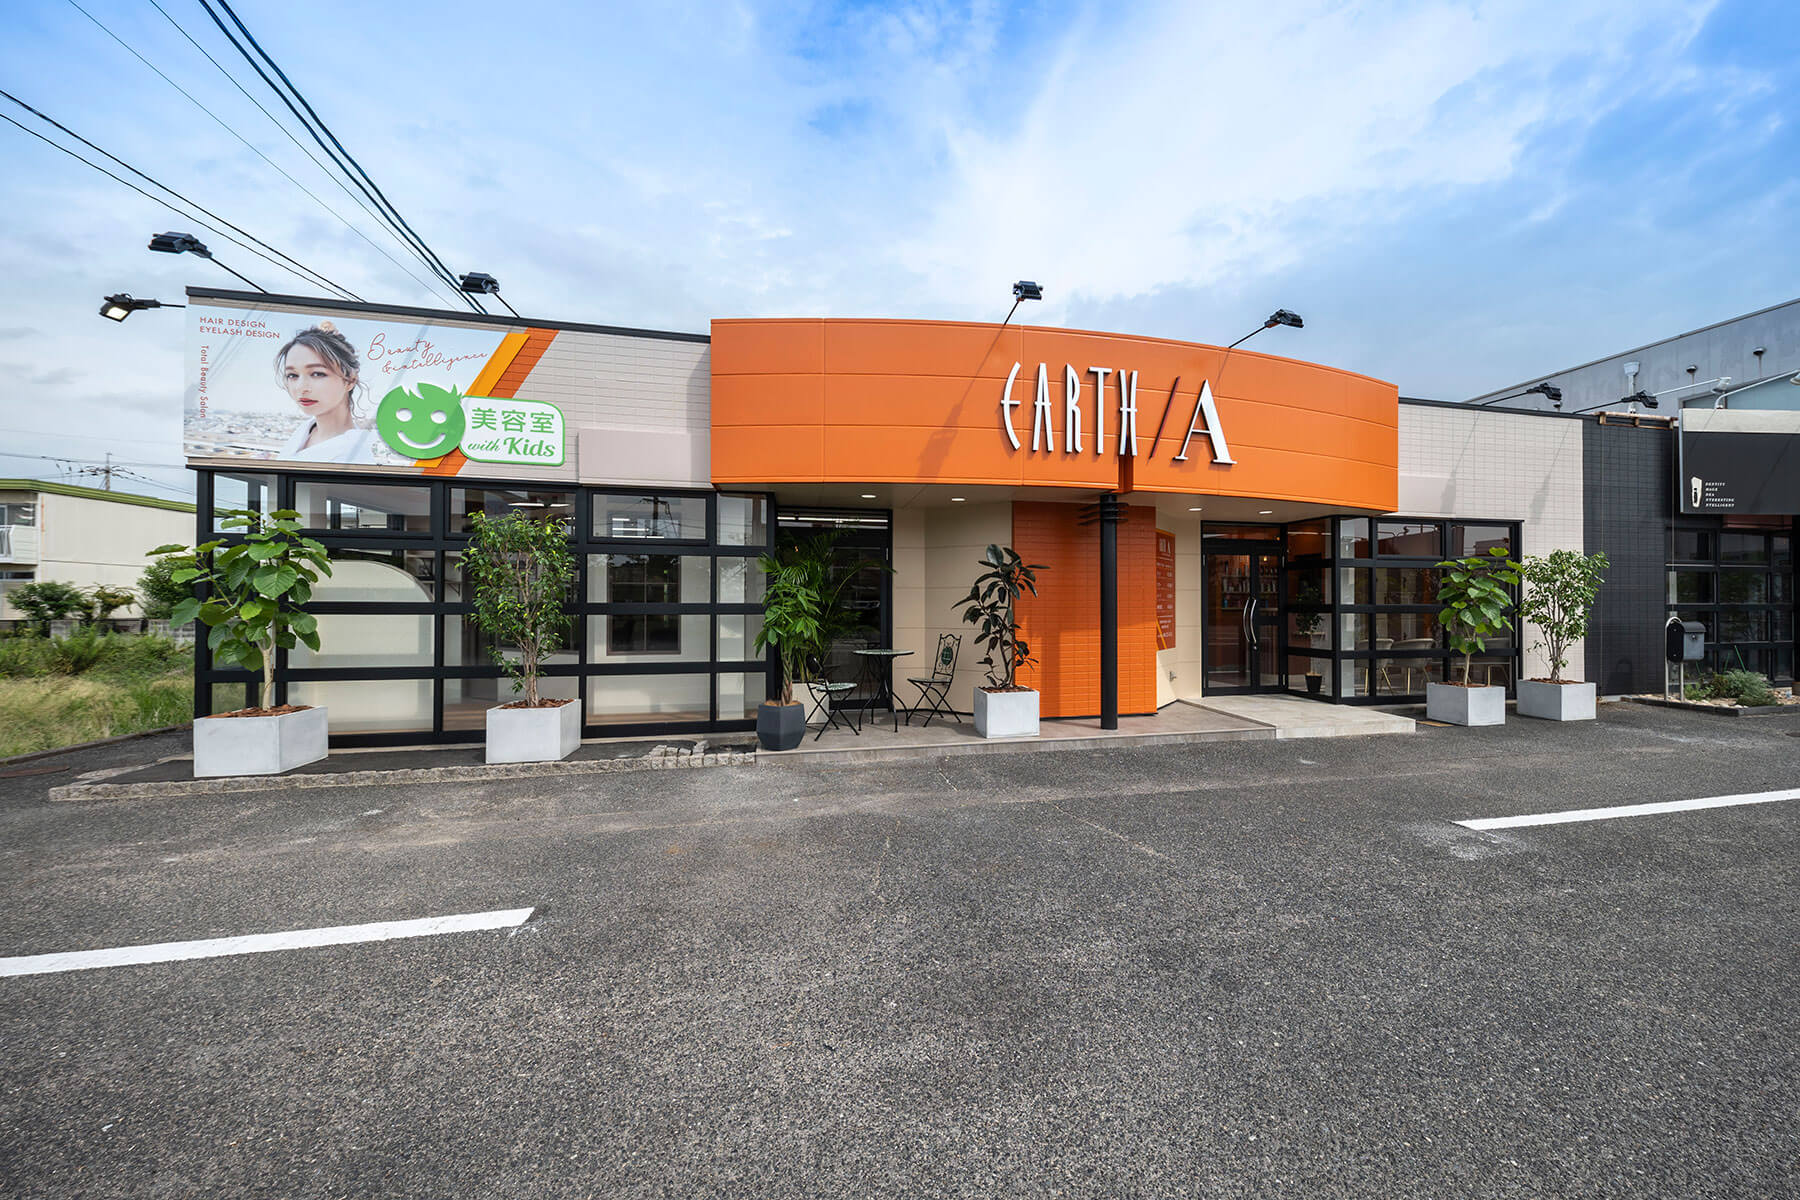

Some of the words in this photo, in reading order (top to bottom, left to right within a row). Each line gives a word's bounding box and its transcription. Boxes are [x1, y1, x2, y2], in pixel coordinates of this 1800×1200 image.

[199, 316, 224, 325] HAIR
[228, 319, 266, 328] DESIGN
[199, 325, 243, 336] EYELASH
[245, 329, 281, 339] DESIGN
[200, 345, 209, 365] Total
[367, 332, 434, 360] Beauty
[198, 367, 209, 393] Beauty
[200, 396, 209, 419] Salon
[1000, 361, 1139, 457] EARTH
[1174, 379, 1238, 465] A
[471, 407, 555, 434] 美容室
[467, 438, 501, 452] with
[503, 437, 556, 457] Kids
